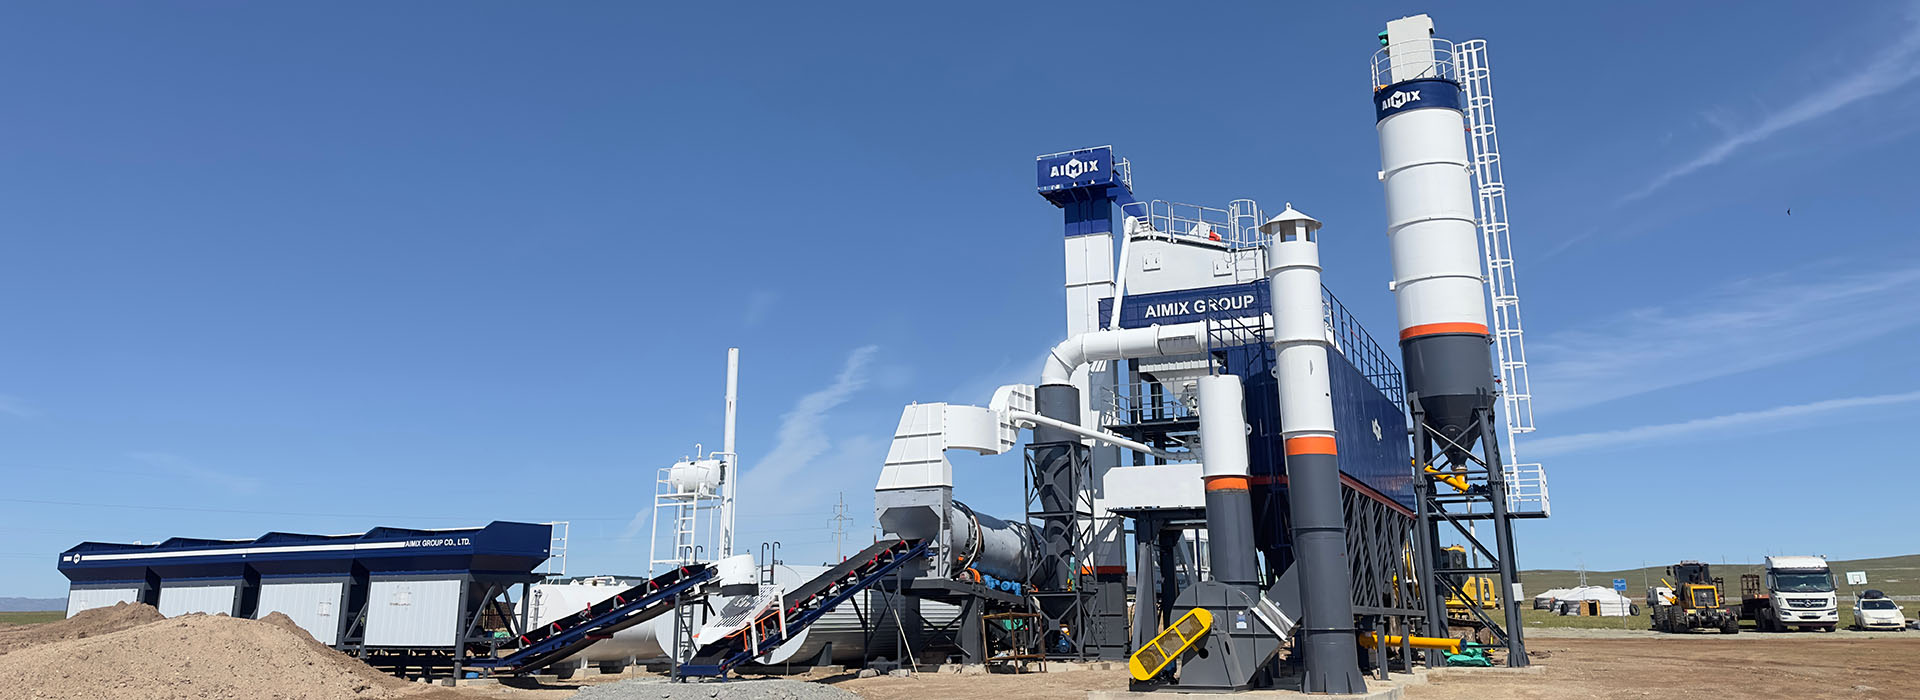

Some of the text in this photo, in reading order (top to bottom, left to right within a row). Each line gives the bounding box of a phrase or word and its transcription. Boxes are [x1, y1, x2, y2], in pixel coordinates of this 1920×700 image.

[1381, 90, 1421, 111] AIMIX
[1050, 158, 1099, 179] AIMIX
[1144, 294, 1254, 319] AIMIX GROUP
[422, 539, 443, 547] GROUP
[457, 538, 470, 546] LTD.
